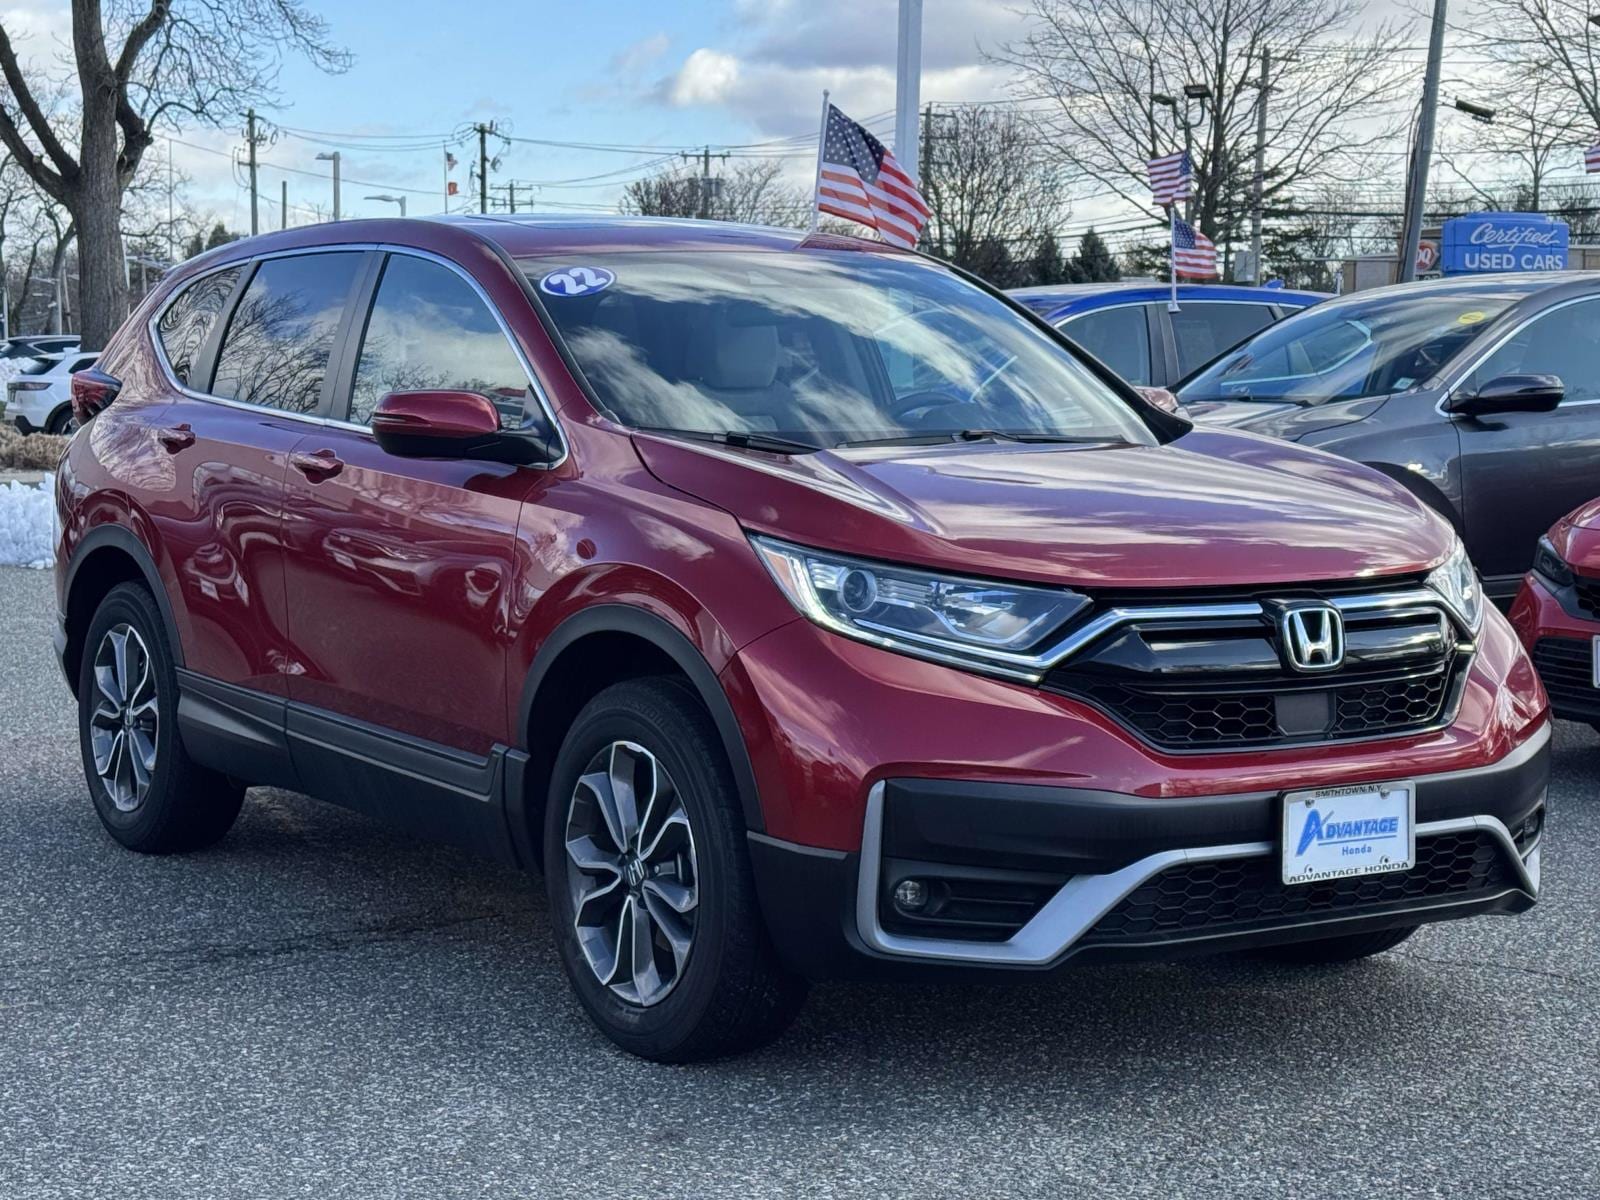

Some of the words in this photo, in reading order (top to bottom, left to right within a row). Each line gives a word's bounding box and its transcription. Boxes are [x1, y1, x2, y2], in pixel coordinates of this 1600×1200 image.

[1470, 223, 1560, 251] Certified
[1465, 253, 1516, 270] USED
[1521, 254, 1564, 270] CARS
[548, 267, 608, 295] 22
[1295, 808, 1400, 857] ADVANTAGE
[1342, 844, 1372, 856] Honda
[1289, 867, 1361, 882] ADVANTAGE
[1364, 862, 1409, 873] HONDA
